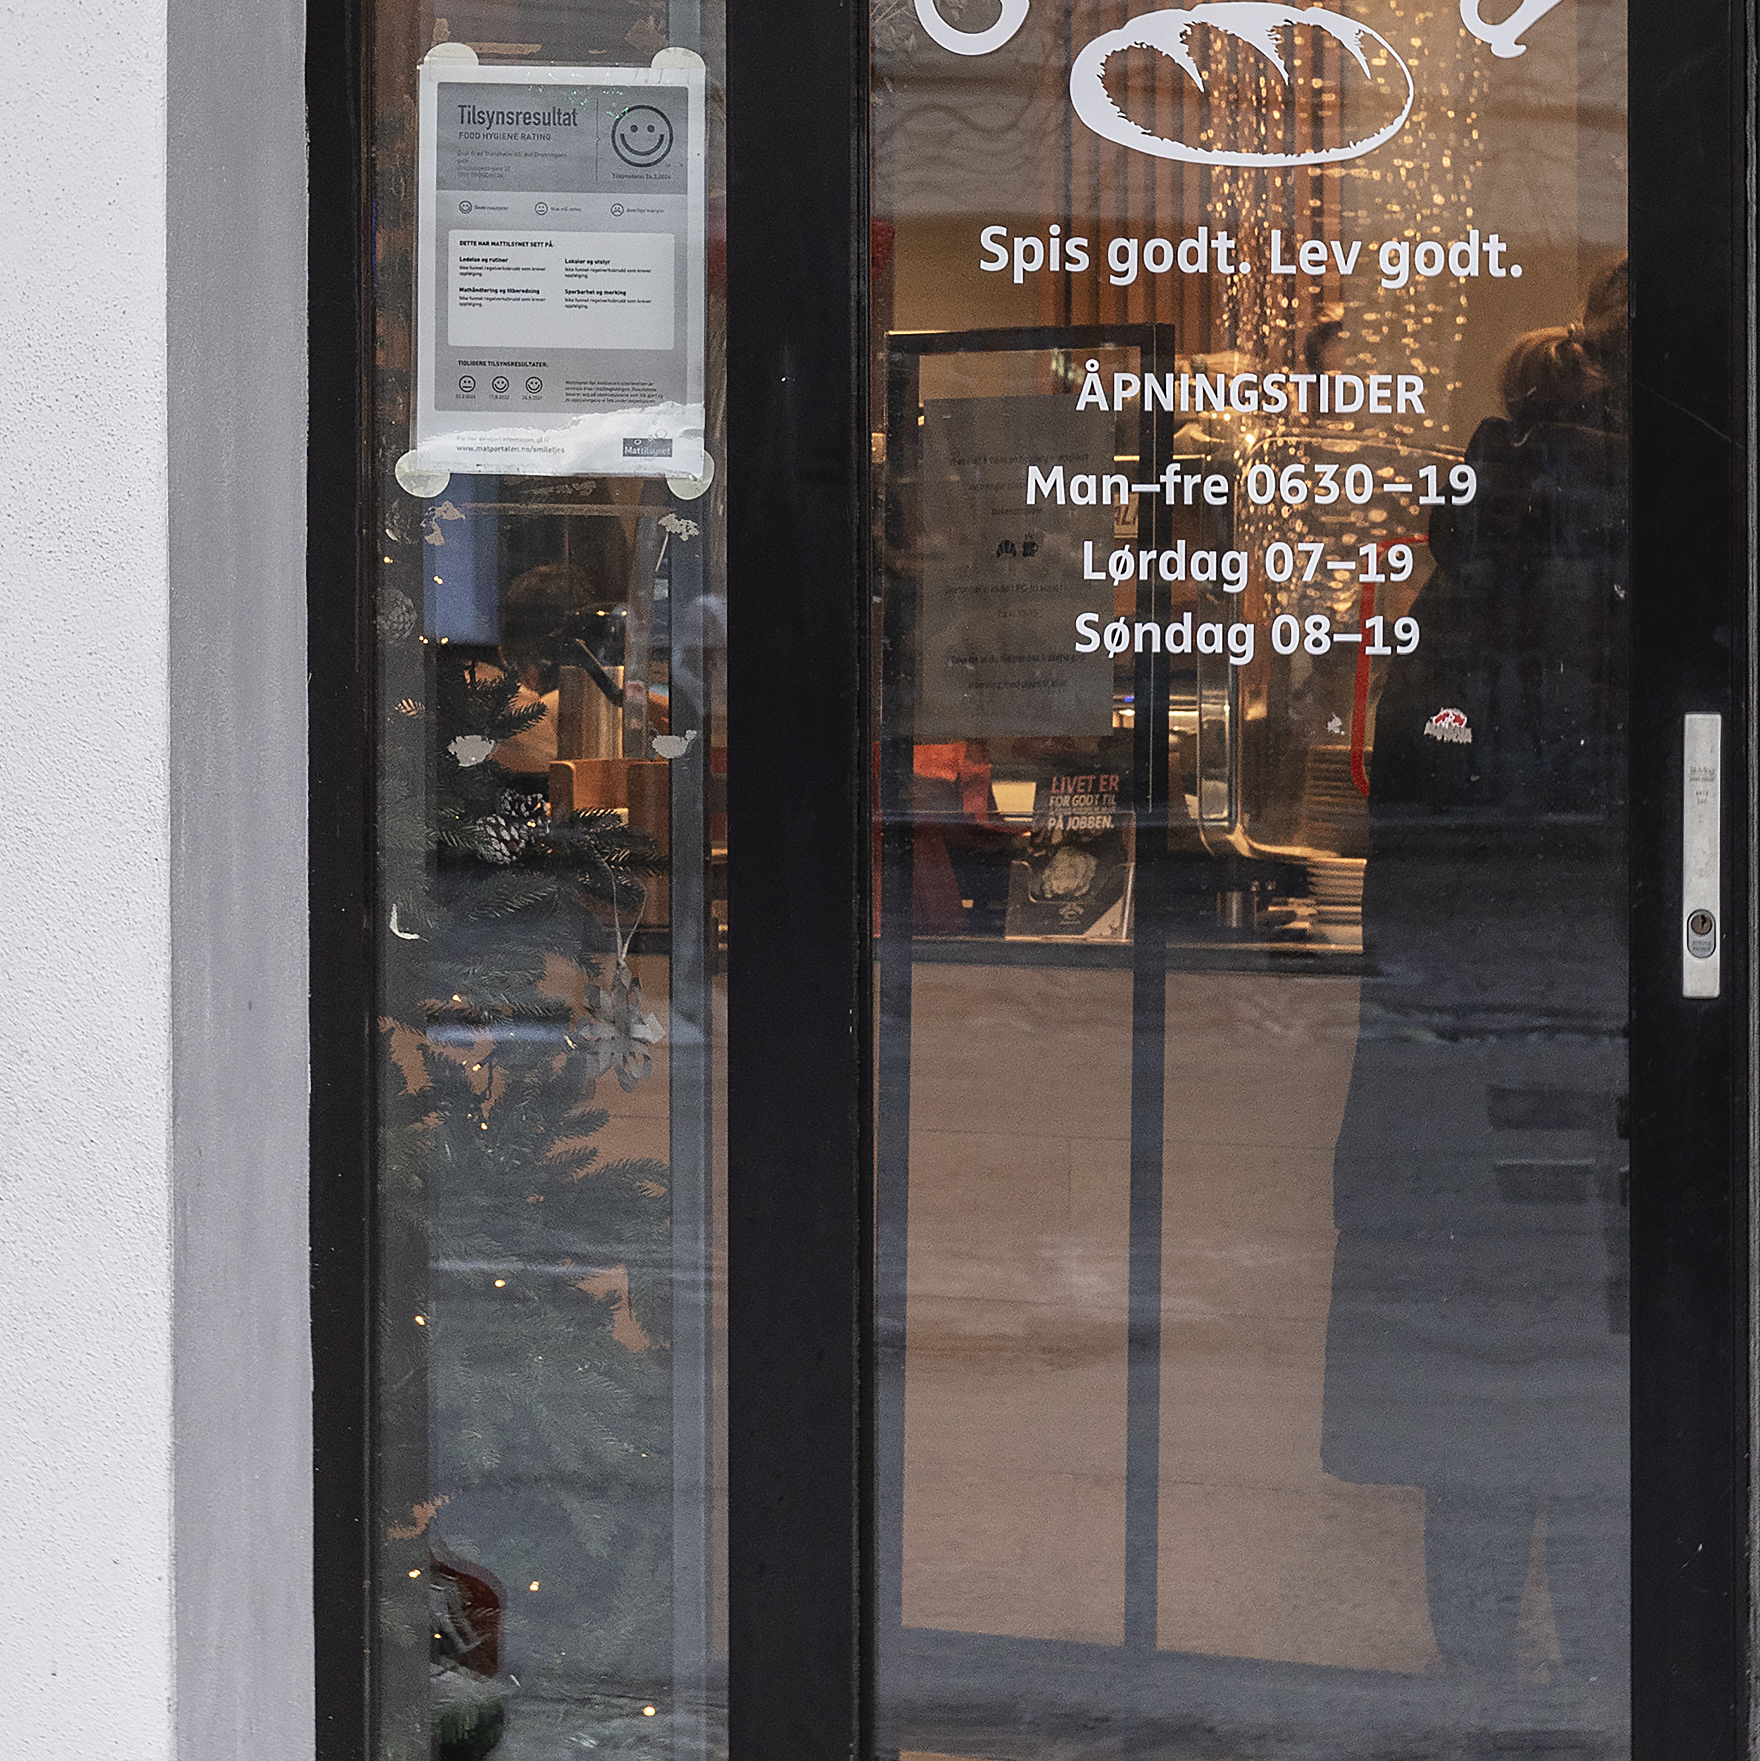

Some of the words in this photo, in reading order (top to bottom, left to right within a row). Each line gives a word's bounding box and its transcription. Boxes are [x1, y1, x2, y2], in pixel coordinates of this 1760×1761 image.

[458, 105, 578, 130] Tilsynsresultat
[458, 131, 481, 140] FOOD
[482, 132, 519, 141] HYGIENE
[520, 133, 552, 141] RATING
[978, 224, 1091, 284] Spis
[1108, 227, 1252, 287] godt.
[1270, 228, 1362, 276] Lev
[1378, 230, 1524, 290] godt.
[1075, 359, 1426, 414] ÅPNINGSTIDER
[624, 445, 671, 456] Mattilsynet
[1082, 540, 1250, 593] Lørdag
[1074, 612, 1256, 666] Søndag
[1051, 774, 1097, 794] LIVET
[1099, 774, 1120, 793] ER
[1049, 794, 1071, 807] FOR
[1071, 793, 1101, 807] GODT
[1102, 793, 1117, 806] TIL
[1047, 813, 1064, 831] PÅ
[1065, 814, 1116, 831] JOBBEN.
